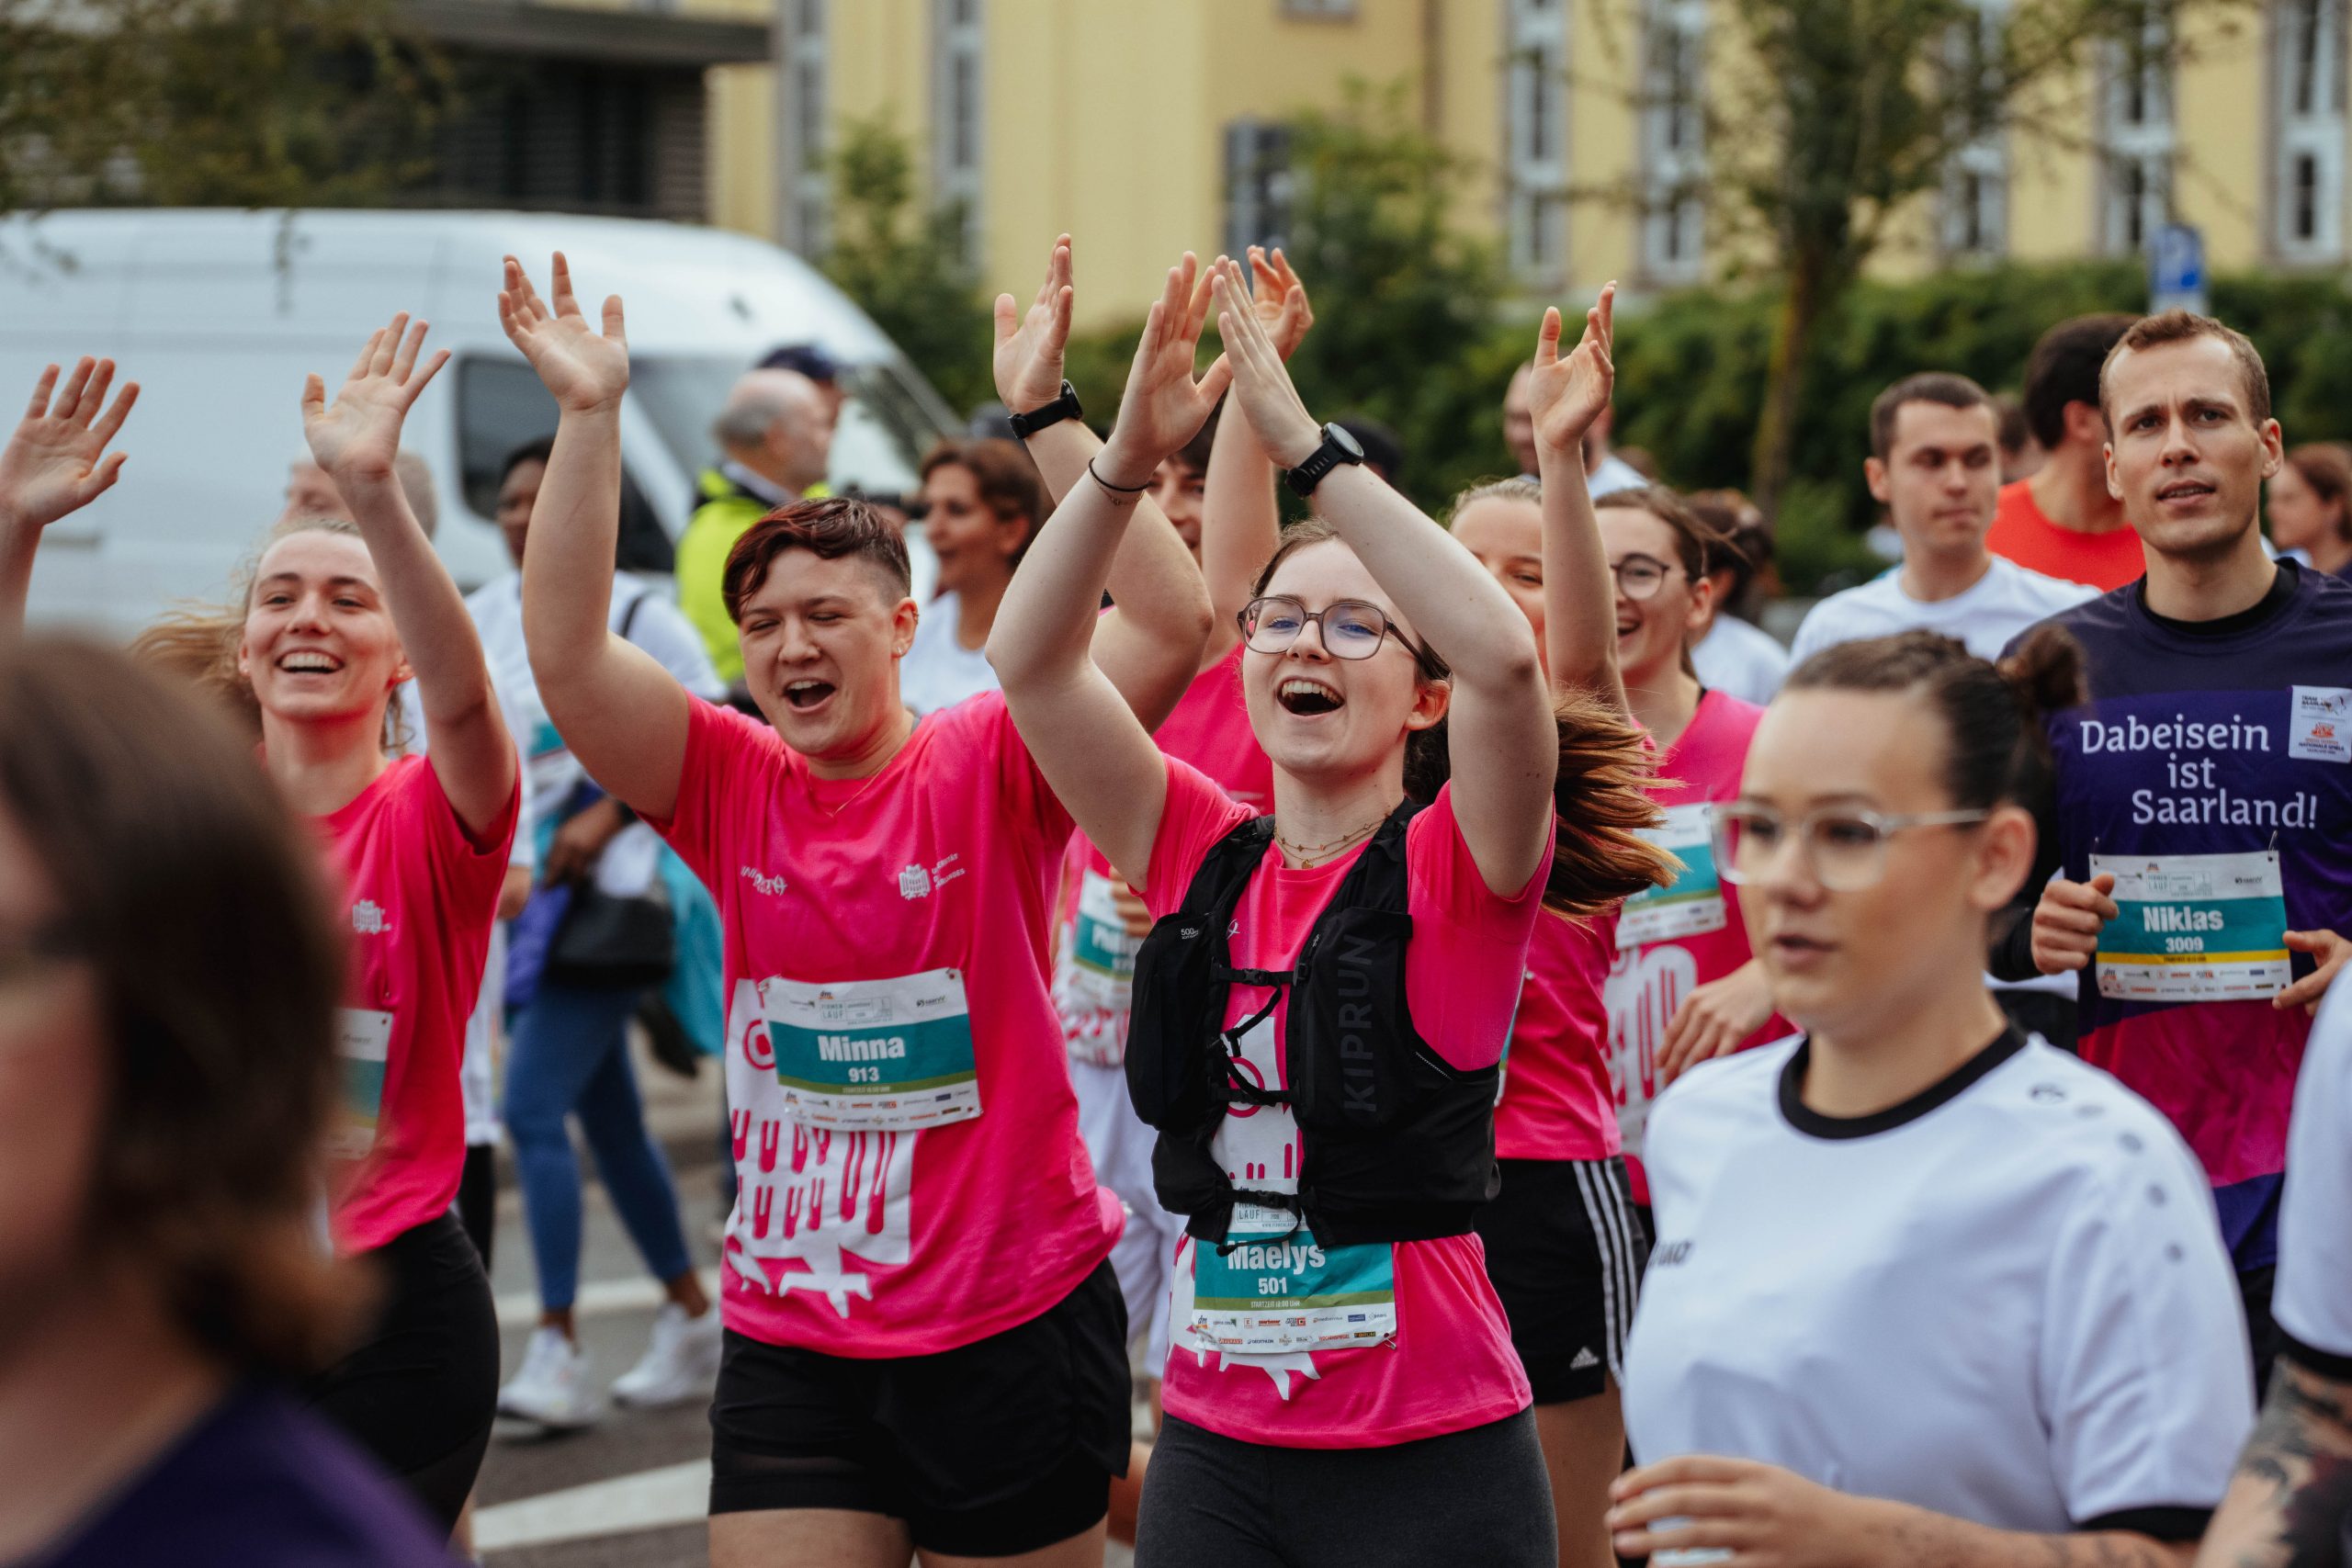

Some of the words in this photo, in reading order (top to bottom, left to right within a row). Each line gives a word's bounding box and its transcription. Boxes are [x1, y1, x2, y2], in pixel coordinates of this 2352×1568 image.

[2079, 713, 2270, 754] Dabeisein
[2167, 752, 2216, 789] ist
[2132, 787, 2318, 829] Saarland!
[1181, 928, 1194, 936] 500
[2143, 906, 2224, 932] Niklas
[2165, 937, 2204, 953] 3009
[1338, 934, 1378, 1112] KIPRUN
[818, 1034, 906, 1063] Minna
[848, 1066, 880, 1083] 913
[1238, 1209, 1261, 1220] LAUF
[1227, 1240, 1326, 1275] Maelys
[1258, 1277, 1288, 1295] 501
